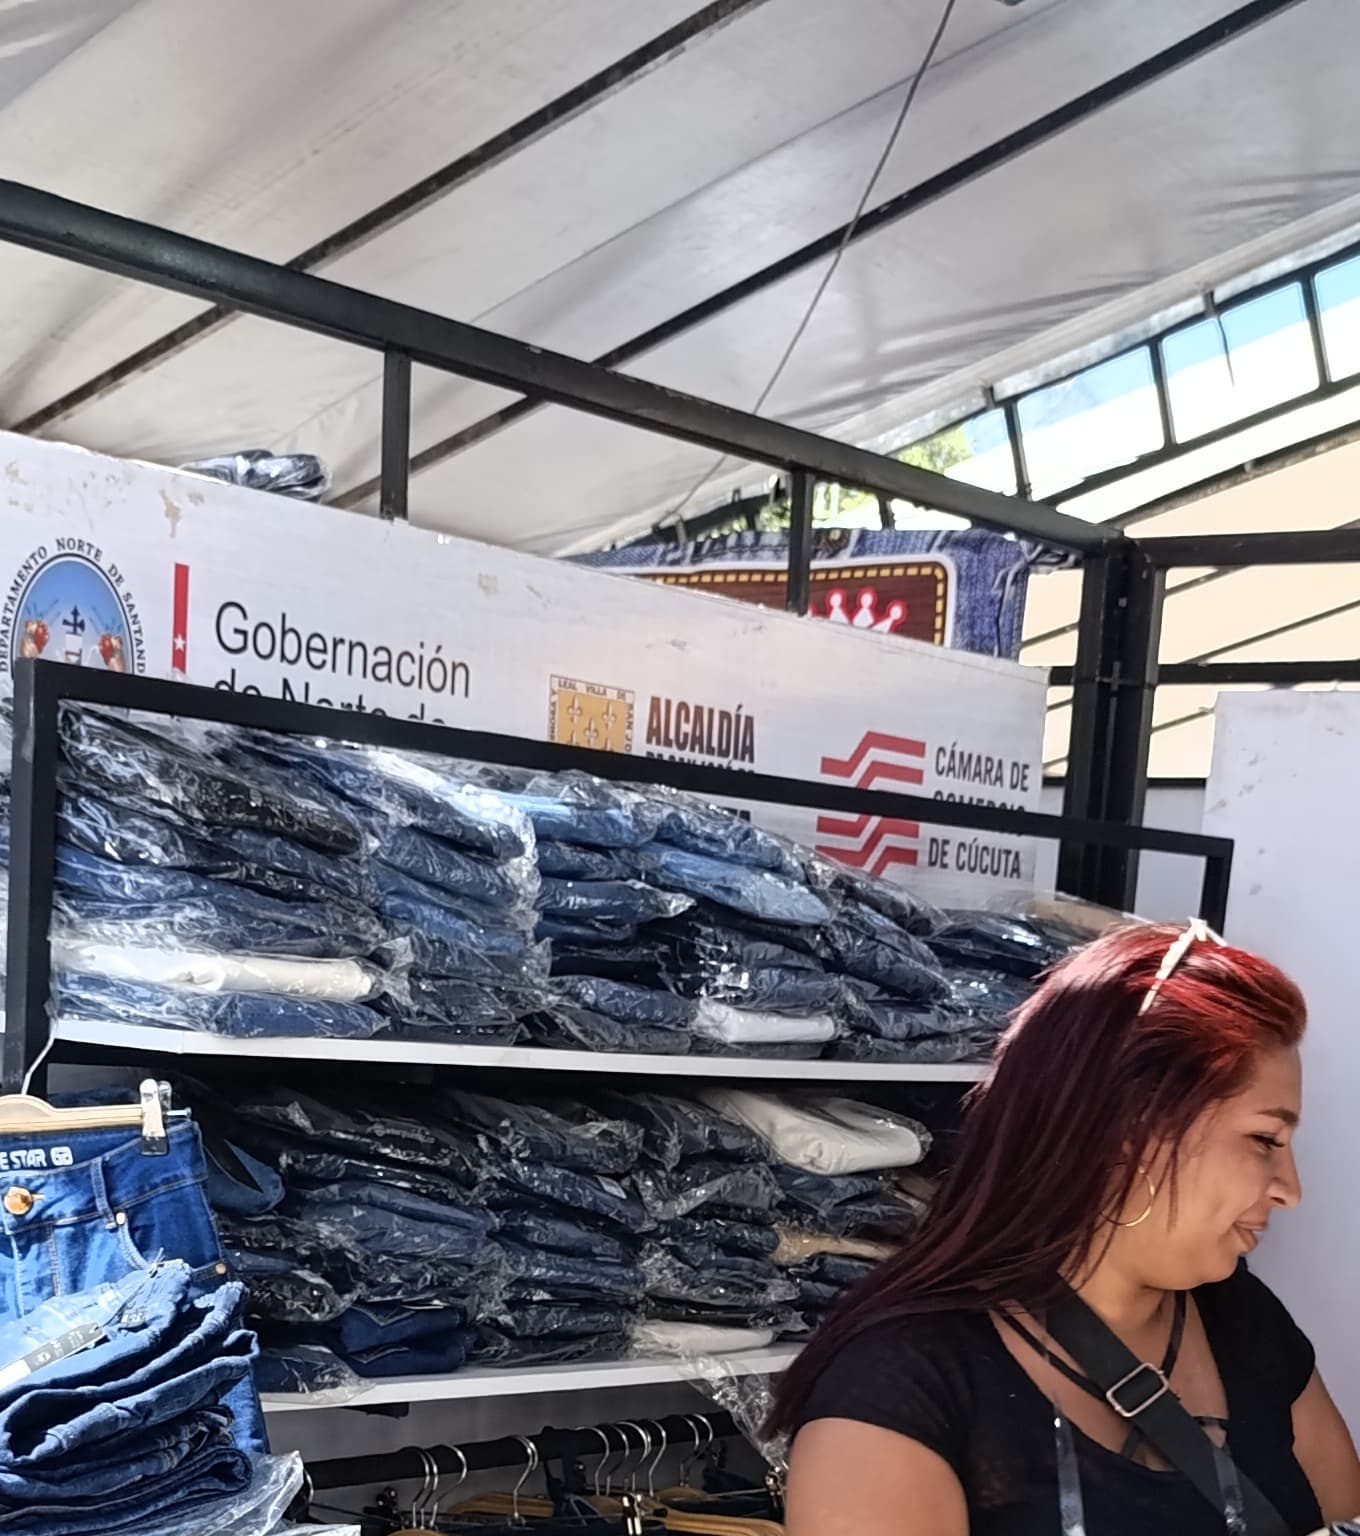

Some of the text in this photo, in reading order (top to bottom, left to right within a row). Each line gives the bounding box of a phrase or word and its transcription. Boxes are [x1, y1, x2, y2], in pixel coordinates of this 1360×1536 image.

[55, 537, 104, 562] NORTE
[107, 563, 125, 588] DE
[122, 592, 146, 674] SANTAND
[215, 601, 471, 698] Gobernación
[645, 695, 755, 764] ALCALDÍA
[934, 741, 1030, 792] CÁMARA DE
[927, 836, 1022, 879] DE CÚCUTA
[9, 1148, 48, 1169] STAR
